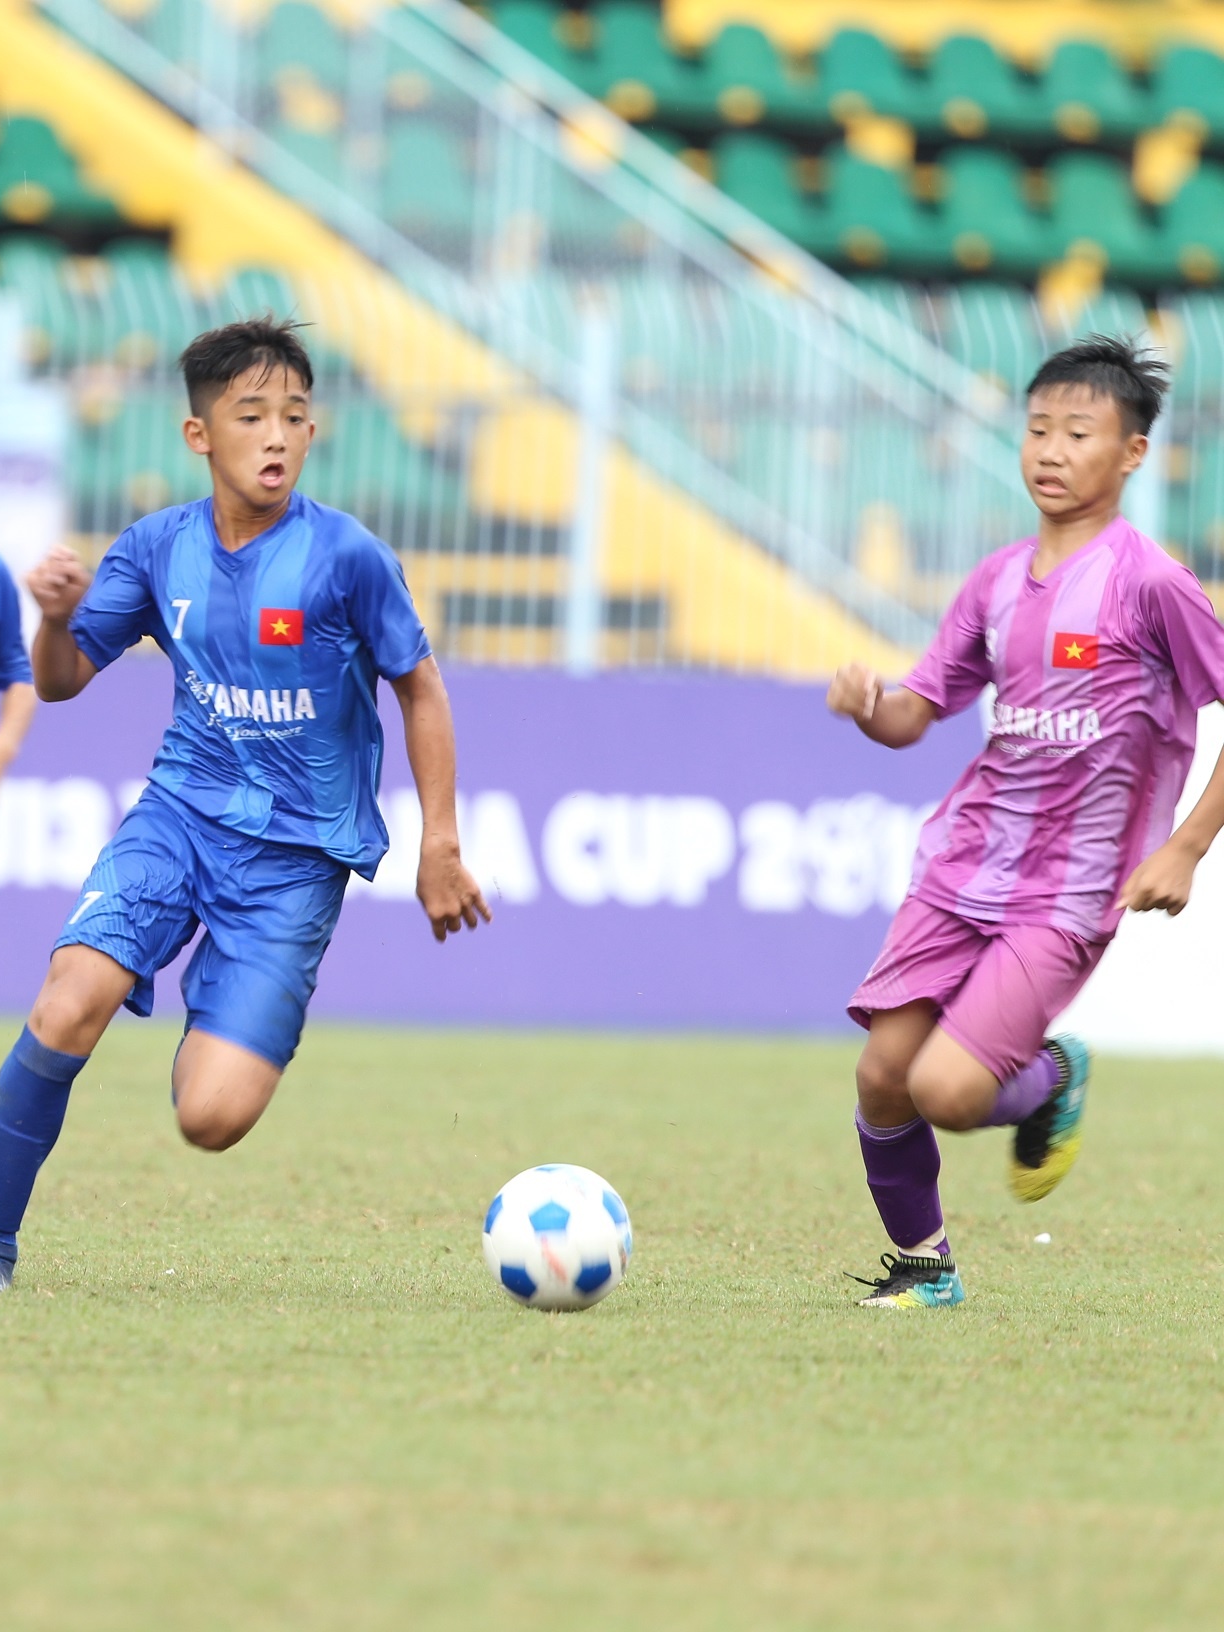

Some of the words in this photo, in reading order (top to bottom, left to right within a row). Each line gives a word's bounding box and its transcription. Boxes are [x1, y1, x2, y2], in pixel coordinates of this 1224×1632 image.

[171, 599, 192, 640] 7
[543, 793, 734, 905] CUP
[68, 891, 104, 925] 7
